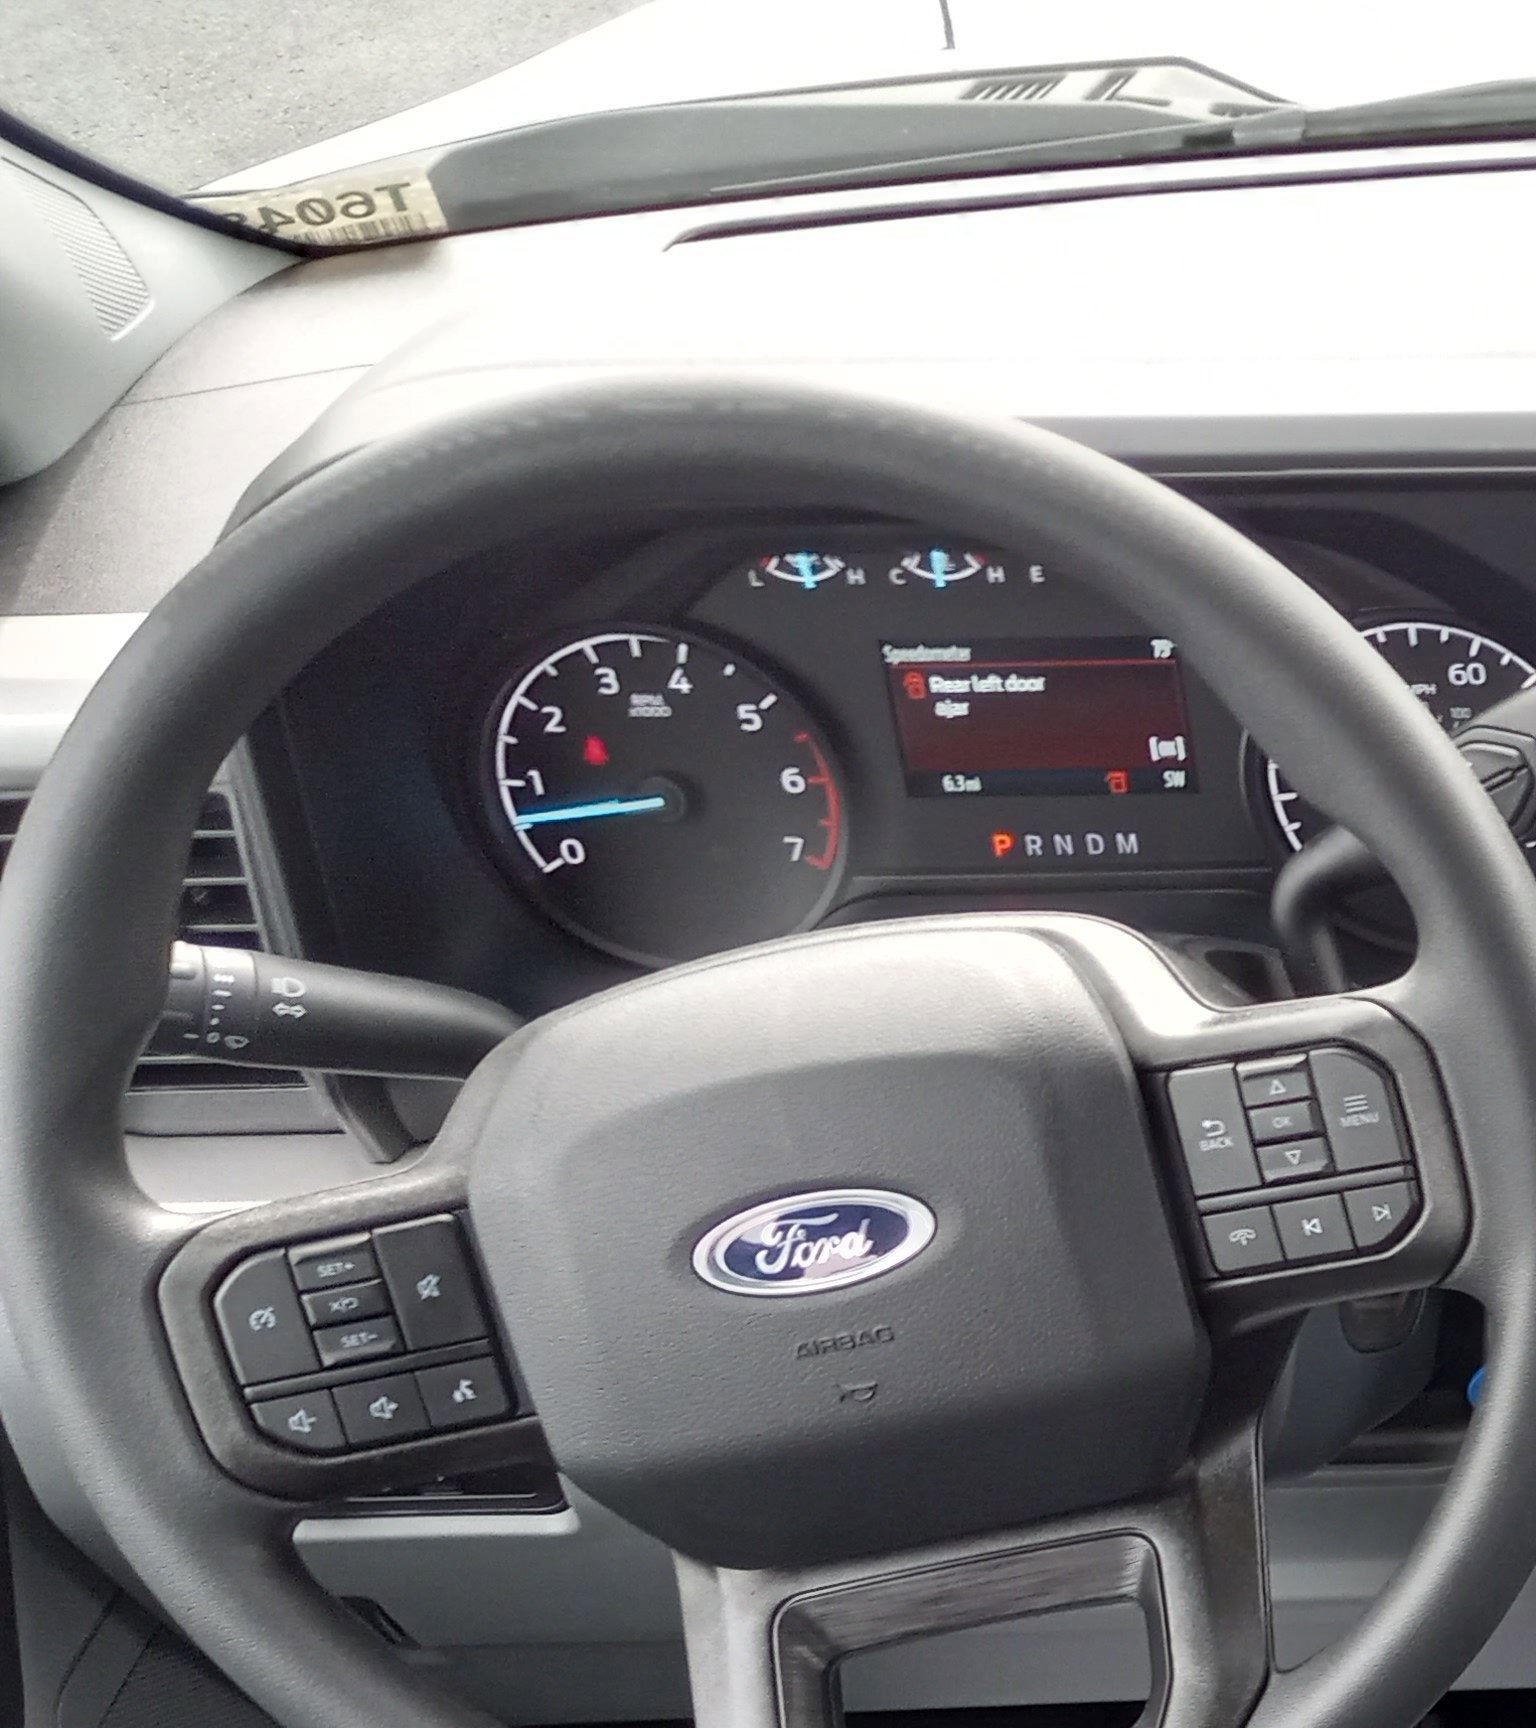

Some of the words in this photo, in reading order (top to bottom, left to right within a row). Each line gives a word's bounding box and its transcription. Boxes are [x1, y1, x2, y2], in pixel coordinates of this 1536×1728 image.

[846, 568, 866, 585] H
[889, 568, 907, 586] C
[986, 566, 1005, 583] H
[1029, 565, 1046, 583] E
[593, 667, 621, 695] 3
[667, 669, 693, 694] 4
[1447, 662, 1487, 686] 60
[540, 706, 567, 733] 2
[737, 704, 764, 732] 5
[526, 769, 545, 796] 1
[780, 767, 806, 794] 6
[559, 838, 586, 865] 0
[783, 836, 804, 862] 7
[992, 833, 1015, 856] P
[1024, 834, 1042, 855] R
[1054, 834, 1074, 855] N
[1085, 833, 1104, 854] D
[1116, 832, 1138, 854] M
[1339, 1112, 1379, 1128] MENU
[1199, 1136, 1234, 1151] BACK
[755, 1212, 874, 1275] Ford
[796, 1326, 895, 1360] AIRBAG
